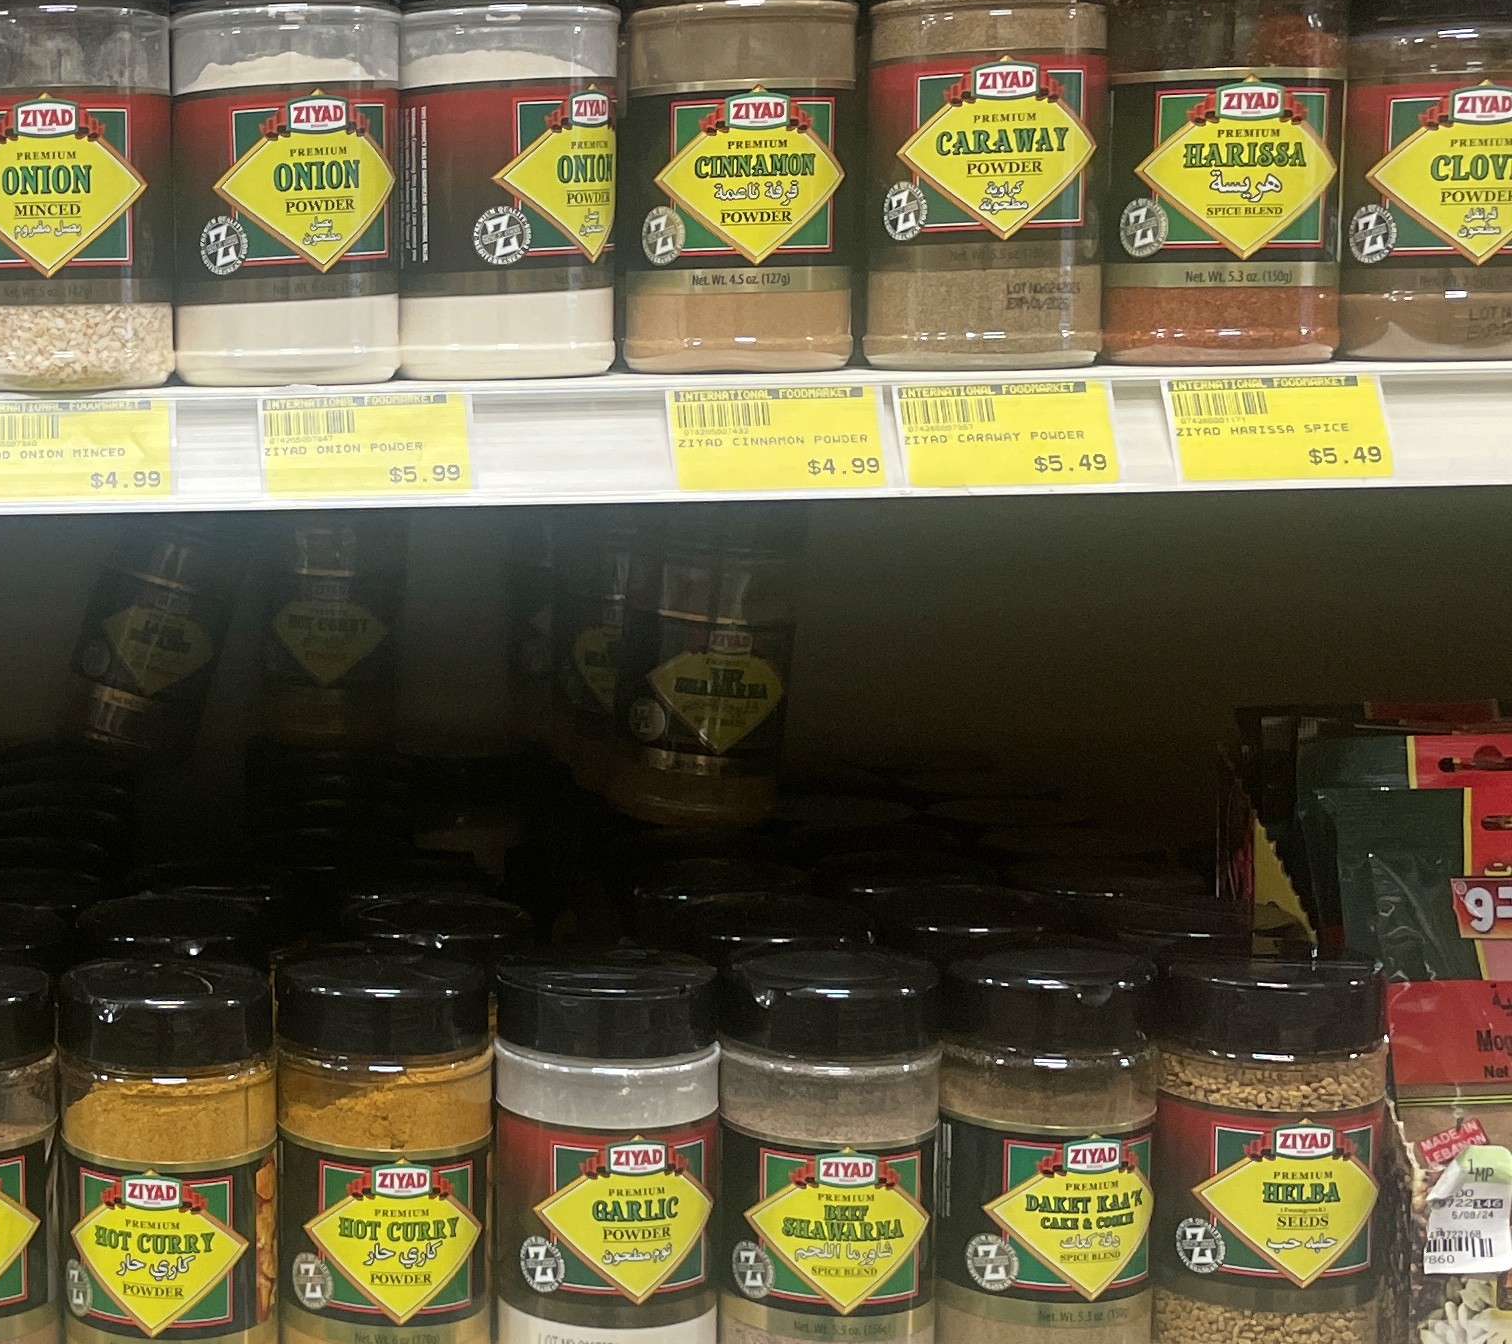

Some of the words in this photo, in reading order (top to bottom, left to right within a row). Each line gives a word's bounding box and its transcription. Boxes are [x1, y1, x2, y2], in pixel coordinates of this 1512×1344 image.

[1222, 91, 1279, 111] ZIYAD
[935, 128, 1070, 155] CARAWAY
[694, 152, 816, 178] CINNAMON
[1183, 142, 1307, 169] HARISSA
[272, 159, 360, 191] ONION
[966, 160, 1043, 175] POWDER
[1, 164, 93, 195] ONION
[1209, 169, 1283, 201] هريسة
[713, 181, 762, 201] ناعمة
[763, 181, 800, 207] قرفة
[14, 203, 82, 217] MINCED
[285, 198, 355, 213] POWDER
[1206, 206, 1240, 217] SPICE
[1243, 205, 1284, 216] BLEND
[720, 209, 793, 225] POWDER
[264, 446, 308, 456] ZIYAD
[316, 443, 361, 454] ONION
[369, 441, 424, 452] POWDER
[1308, 447, 1383, 466] $5.49
[807, 456, 881, 476] $4.99
[1033, 453, 1108, 473] $5.49
[89, 470, 162, 489] $4.99
[388, 464, 461, 483] $5.99
[1278, 1132, 1331, 1151] ZIYAD
[612, 1147, 663, 1166] ZIYAD
[1025, 1193, 1091, 1214] DAKET
[1096, 1188, 1145, 1214] KAA'K
[1261, 1181, 1341, 1205] HELBA
[591, 1195, 680, 1222] GARLIC
[822, 1204, 870, 1221] BEEF
[338, 1217, 380, 1239] HOT
[386, 1216, 461, 1242] CURRY
[781, 1218, 905, 1242] SHAWARMA
[1276, 1214, 1329, 1229] SEEDS
[602, 1225, 672, 1242] POWDER
[370, 1273, 433, 1286] POWDER
